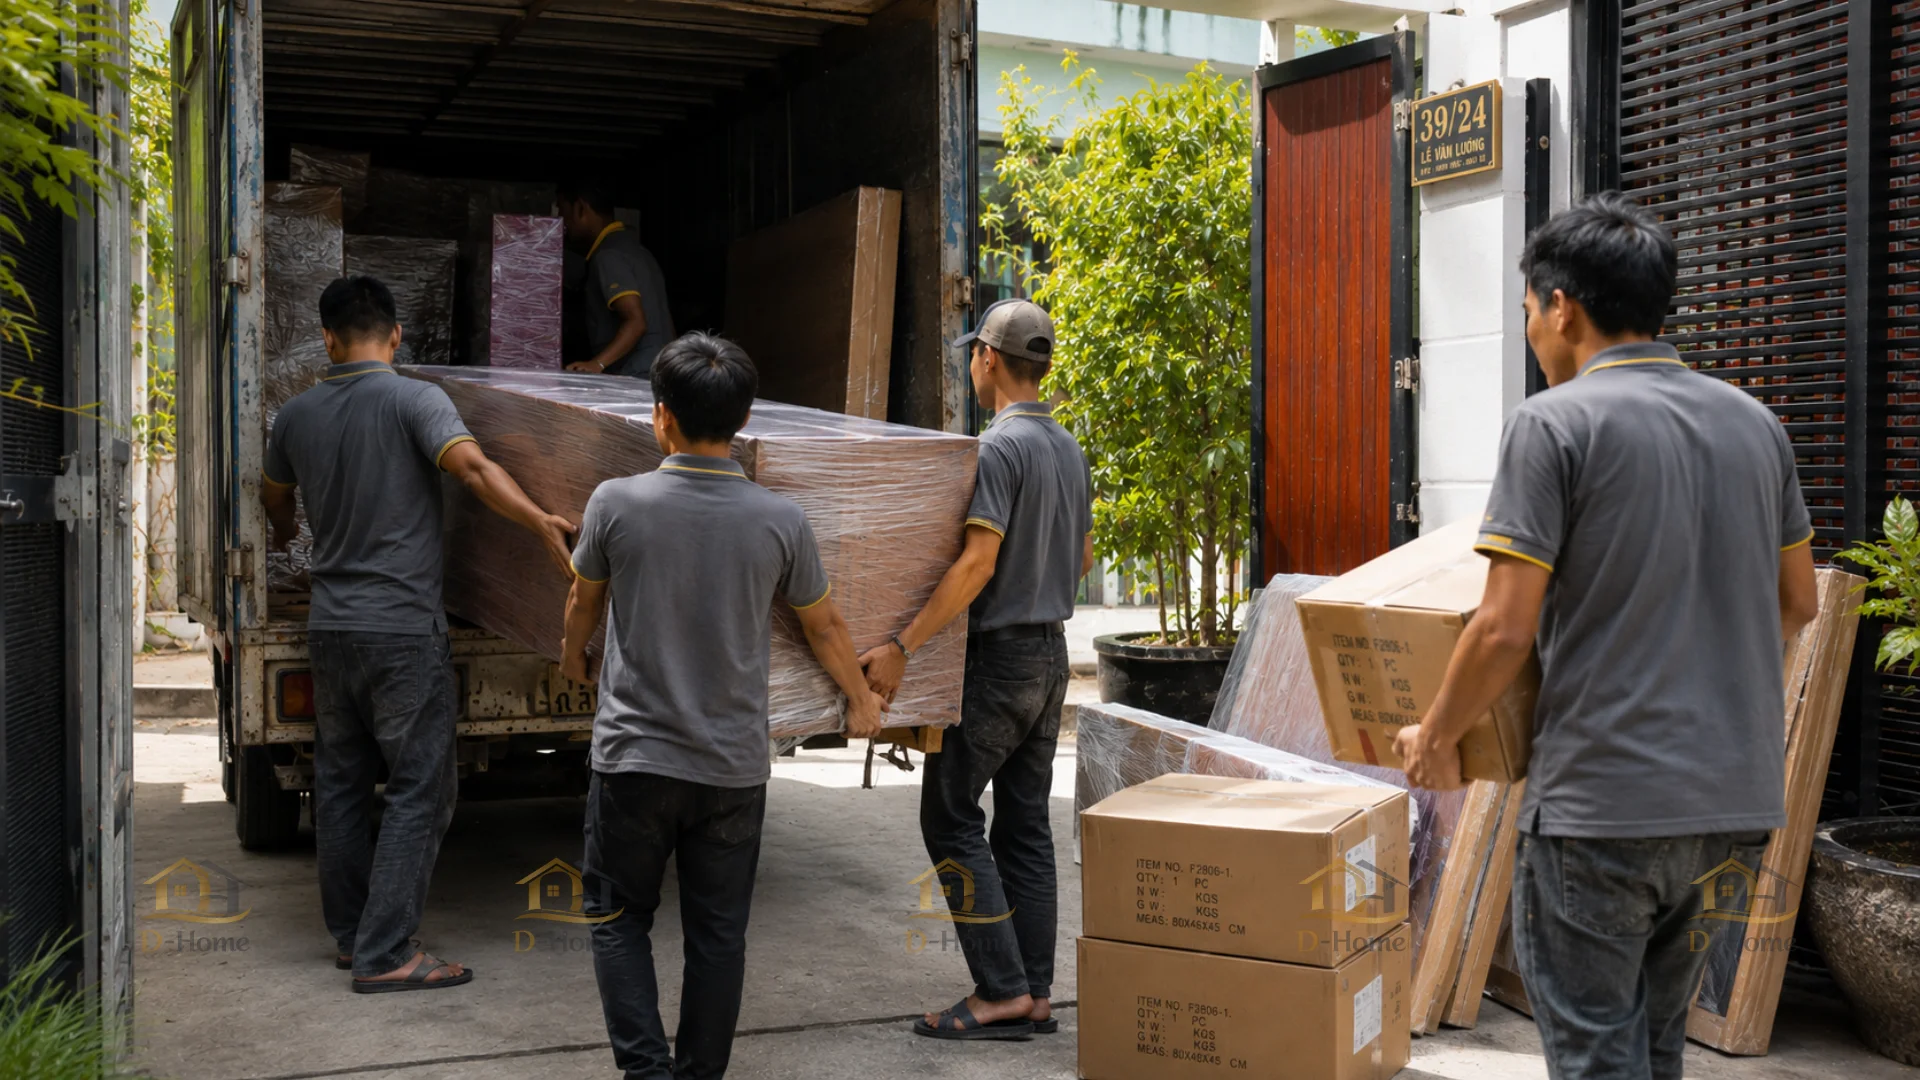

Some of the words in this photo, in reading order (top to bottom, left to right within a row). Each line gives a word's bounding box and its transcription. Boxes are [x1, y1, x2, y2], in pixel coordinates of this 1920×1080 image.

[1420, 95, 1486, 142] 39/24
[1332, 634, 1353, 648] ITEM
[1368, 657, 1374, 669] 1
[1383, 658, 1398, 672] PC
[1136, 858, 1160, 870] ITEM
[1165, 861, 1184, 873] NO.
[1173, 876, 1178, 886] 1
[1194, 878, 1209, 889] PC
[1136, 913, 1168, 926] MEAS:
[1228, 924, 1246, 935] CM
[1137, 996, 1162, 1008] ITEM
[1165, 1000, 1184, 1012] NO.
[1172, 1014, 1177, 1022] 1
[1191, 1016, 1206, 1027] PC
[1137, 1044, 1169, 1057] MEAS:
[1230, 1058, 1247, 1070] CM
